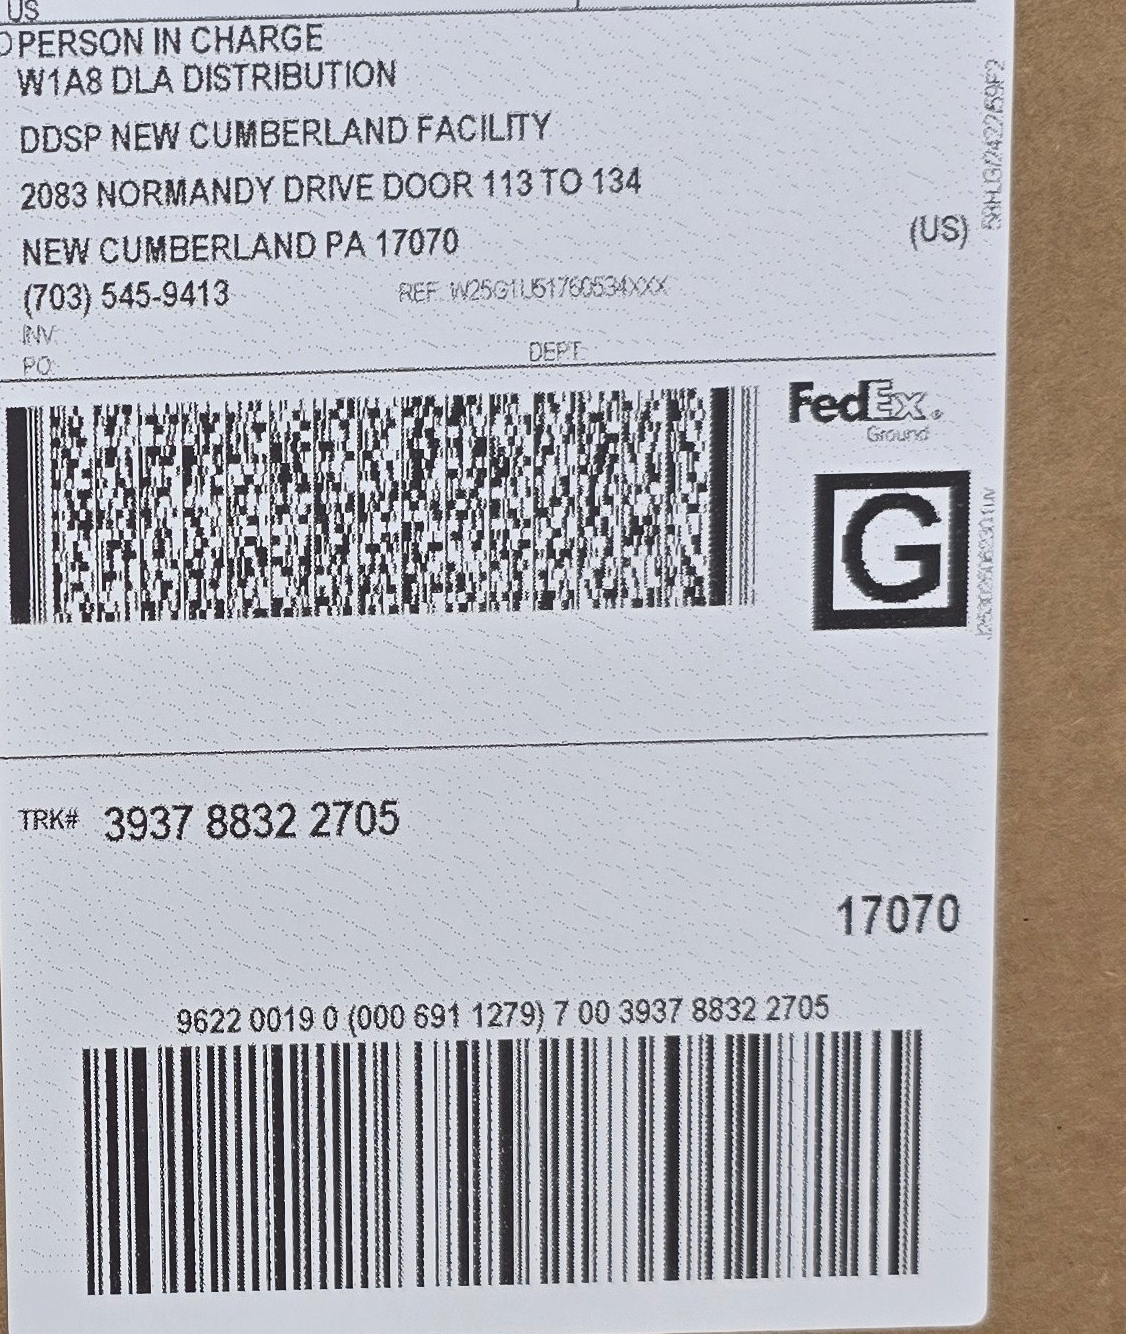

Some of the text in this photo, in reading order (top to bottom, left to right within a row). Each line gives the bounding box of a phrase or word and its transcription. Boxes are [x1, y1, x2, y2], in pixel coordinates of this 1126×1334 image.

[8, 0, 39, 22] US
[18, 28, 143, 57] PERSON
[154, 28, 182, 56] IN
[191, 24, 323, 54] CHARGE
[17, 60, 397, 96] W1A8 DLA DISTRIBUTION
[20, 112, 552, 154] DDSP NEW CUMBERLAND FACILITY
[21, 167, 642, 209] 2083 NORMANDY DRIVE DOOR 113 TO 134
[23, 227, 460, 267] NEW CUMBERLAND PA 17070
[910, 216, 969, 250] (US)
[23, 278, 230, 318] (703) 545-9413
[841, 492, 941, 603] G
[19, 798, 400, 842] TRK# 3937 8832 2705
[837, 892, 960, 936] 17070
[177, 994, 830, 1038] 9622 0019 0 (000 691 1279) 7 00 3937 8832 2705
